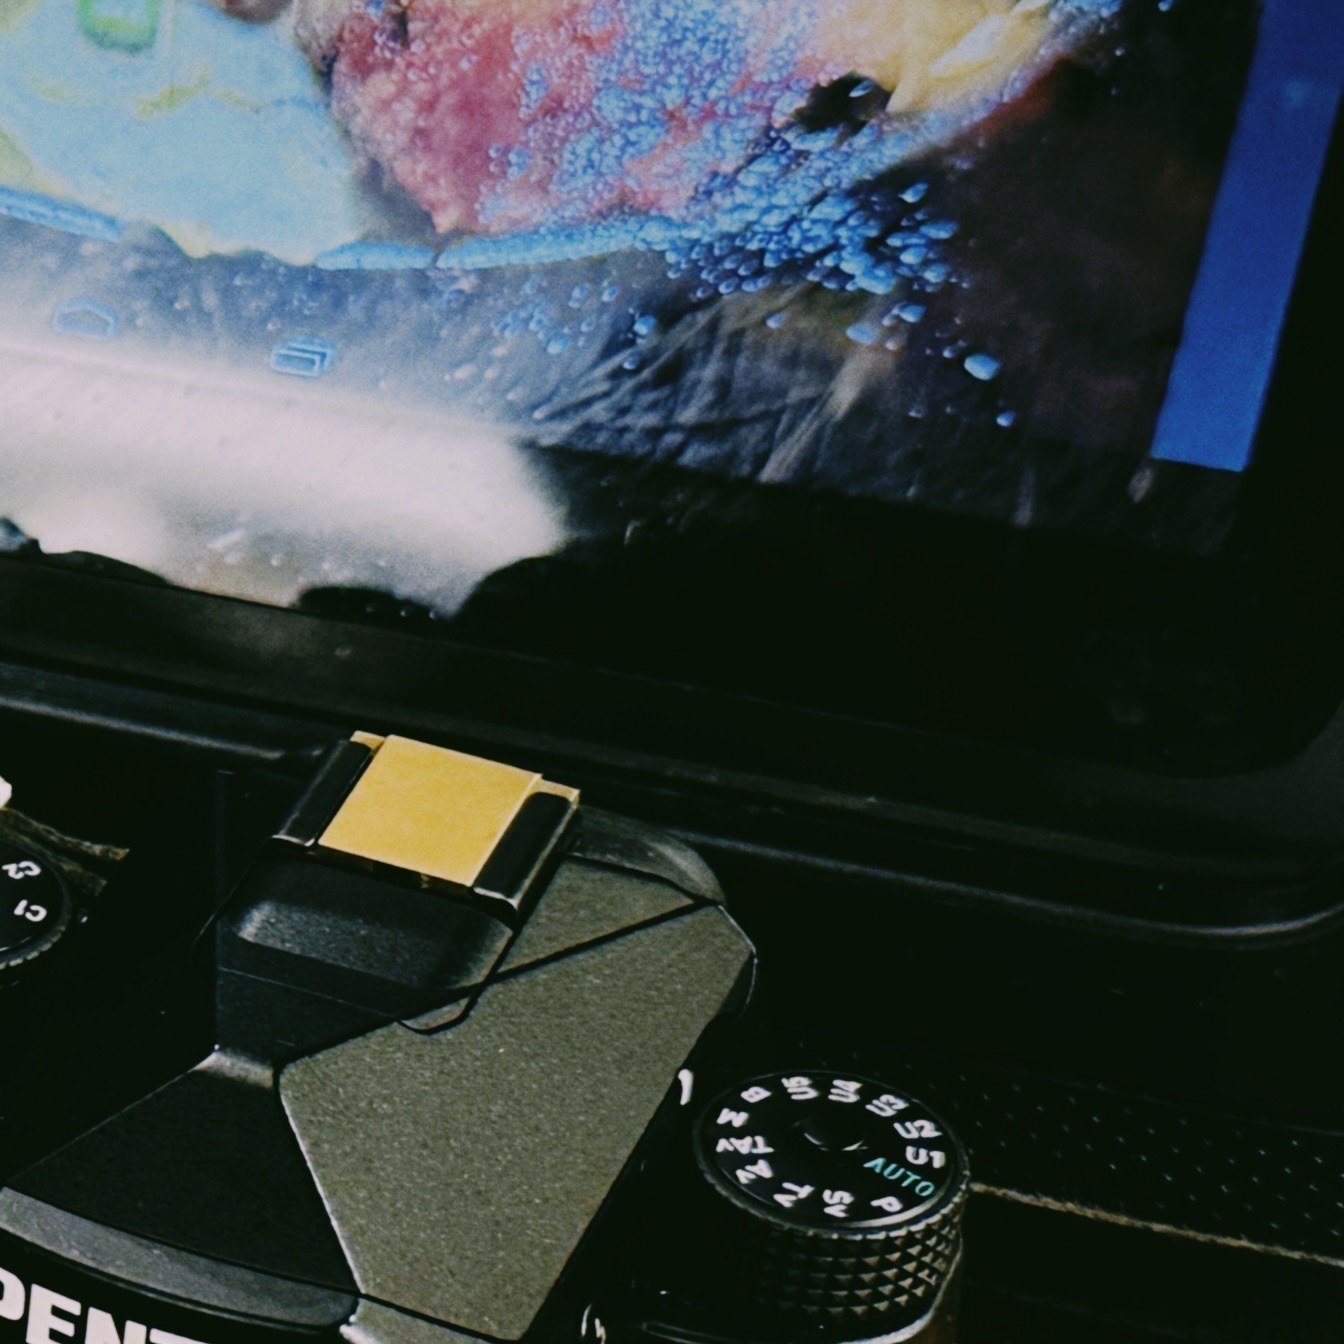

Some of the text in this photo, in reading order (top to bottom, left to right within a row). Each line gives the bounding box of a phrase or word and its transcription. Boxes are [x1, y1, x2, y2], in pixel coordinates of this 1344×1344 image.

[716, 1107, 749, 1128] M
[863, 1157, 936, 1197] AUTO
[870, 1196, 904, 1213] P
